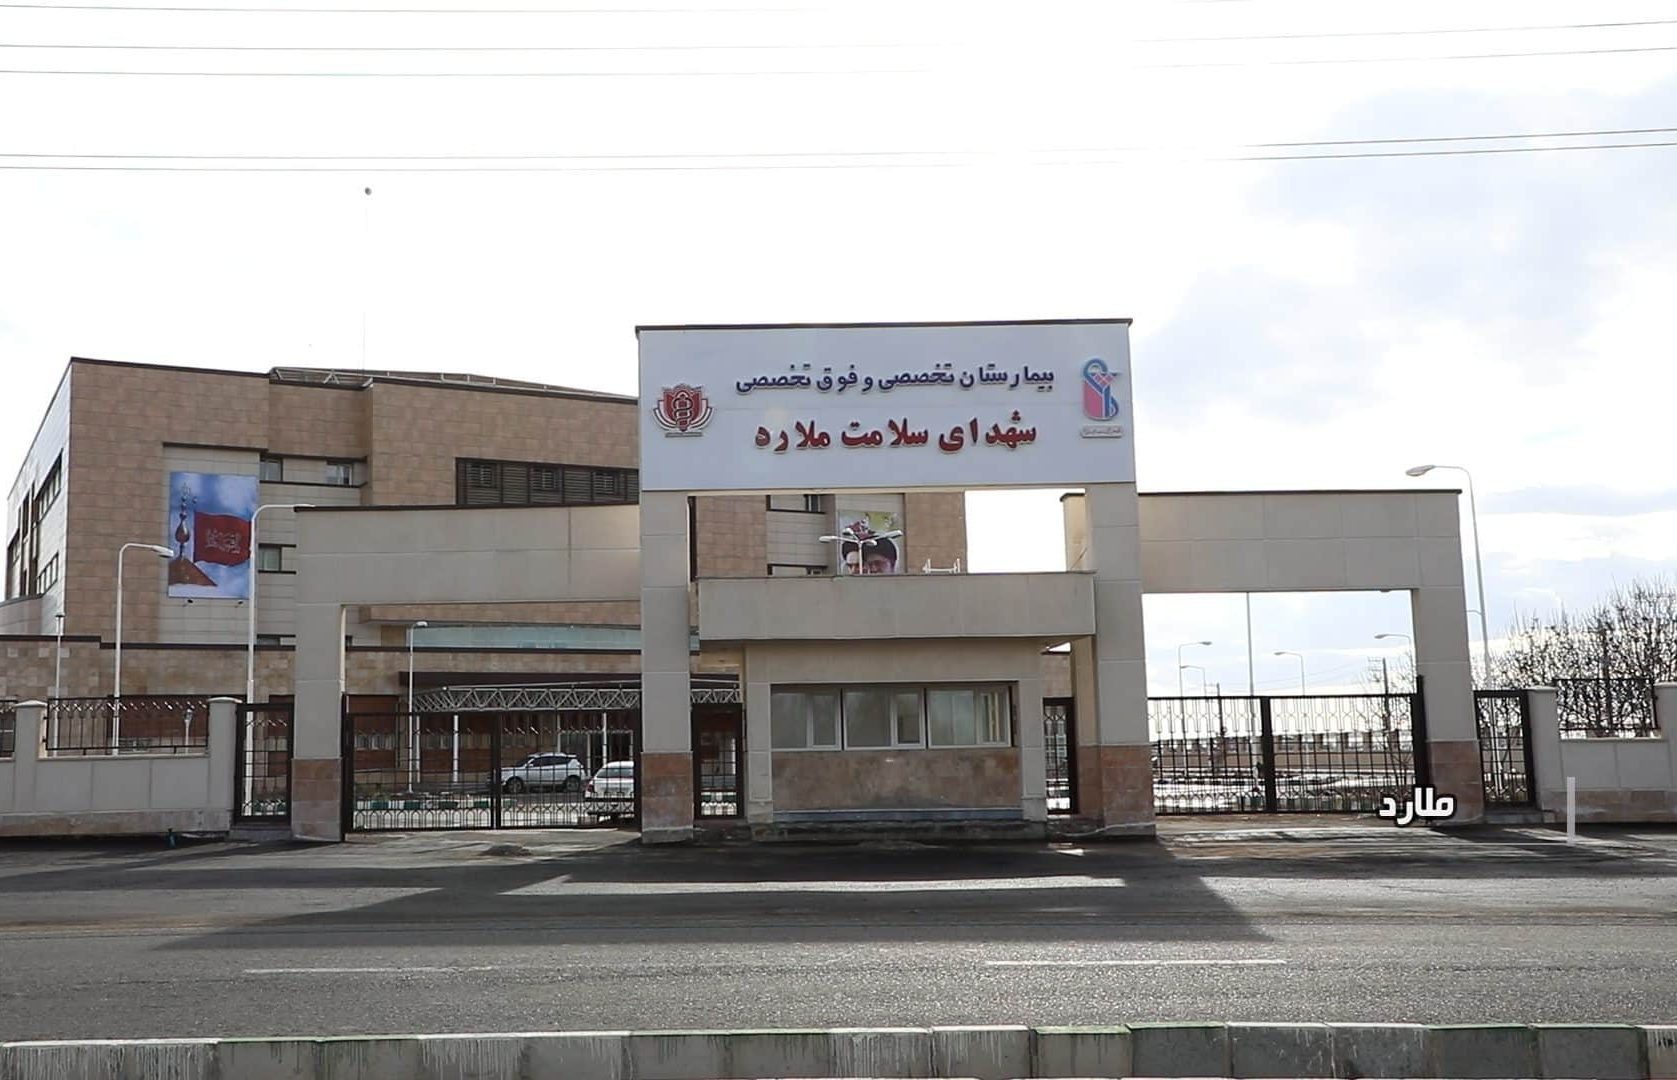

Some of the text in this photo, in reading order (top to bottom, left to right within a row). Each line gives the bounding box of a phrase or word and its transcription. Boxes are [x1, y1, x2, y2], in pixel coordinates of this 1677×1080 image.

[736, 363, 1054, 394] بیمارستان تخصصی و فوق تخصصی
[841, 417, 929, 449] سلامت
[938, 409, 1037, 453] شهدای
